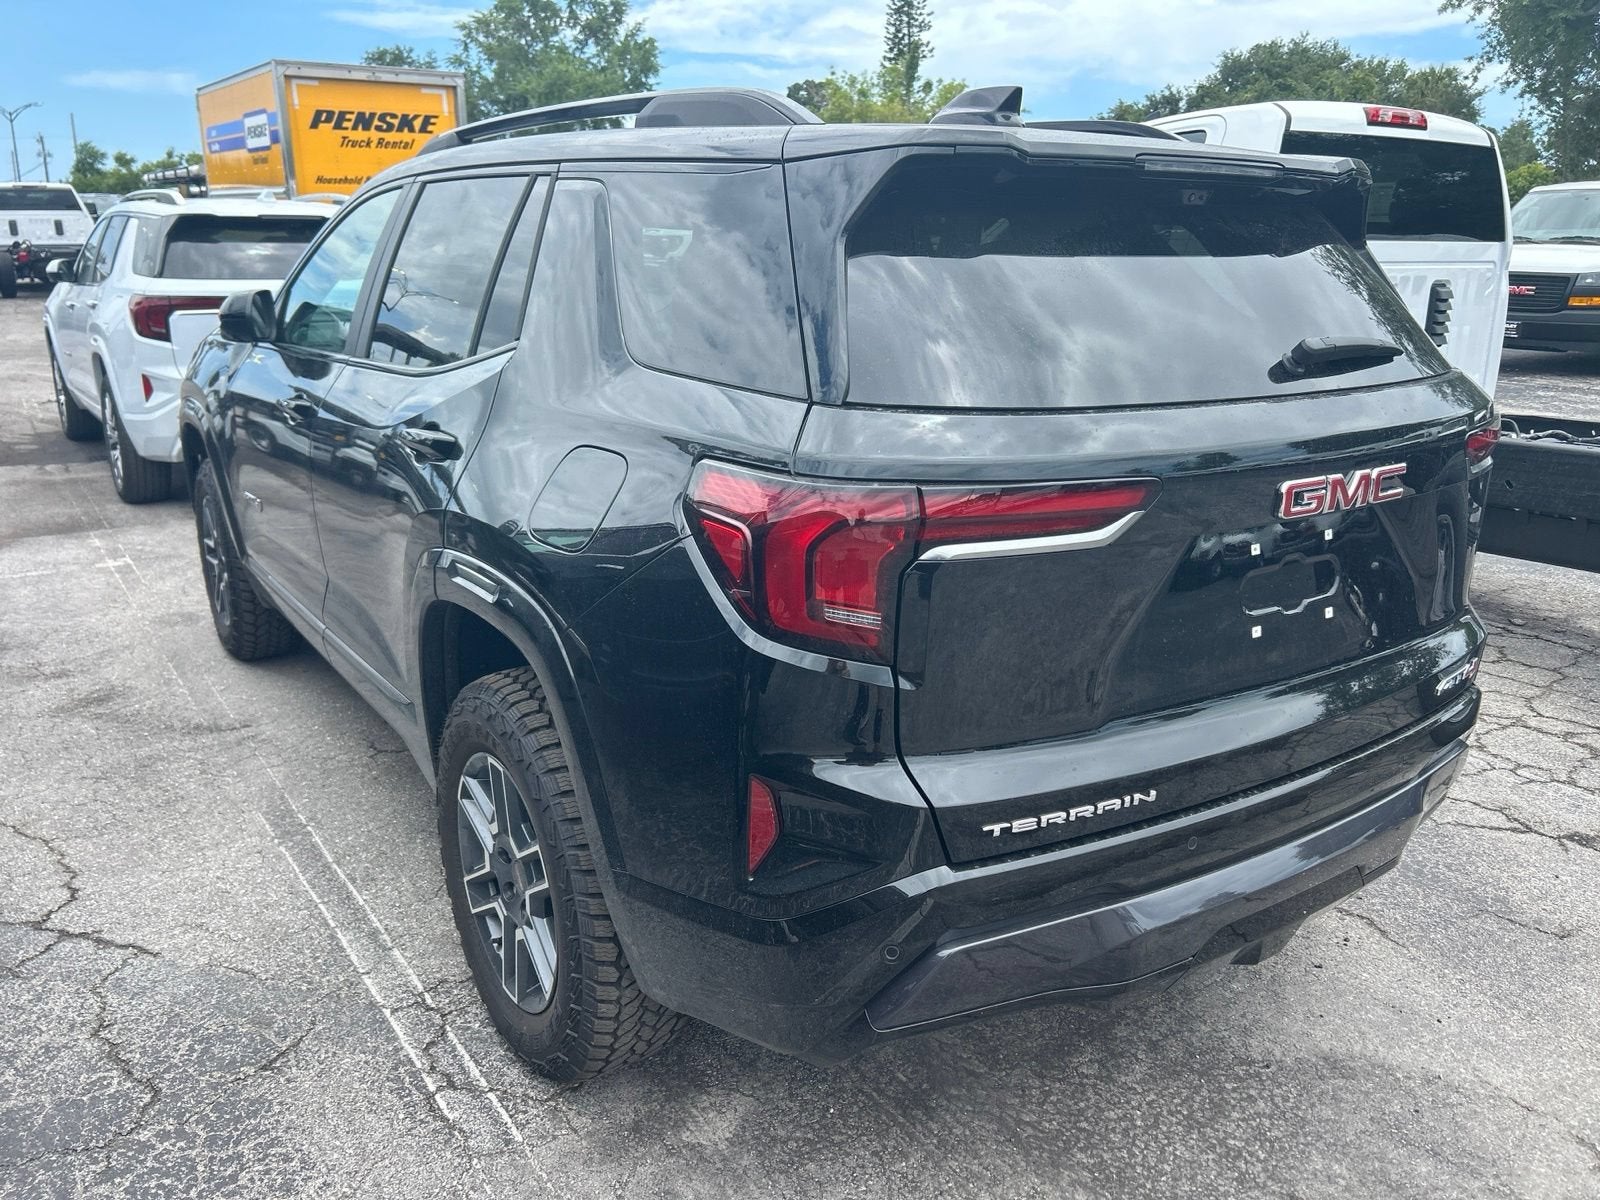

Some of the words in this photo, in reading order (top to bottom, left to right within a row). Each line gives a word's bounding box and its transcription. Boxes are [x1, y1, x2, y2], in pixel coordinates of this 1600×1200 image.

[309, 109, 439, 134] PENSKE
[340, 136, 372, 149] Truck
[375, 137, 414, 150] Rental
[315, 175, 364, 184] Household
[1276, 462, 1407, 519] GMC
[982, 789, 1157, 837] TERRAIN
